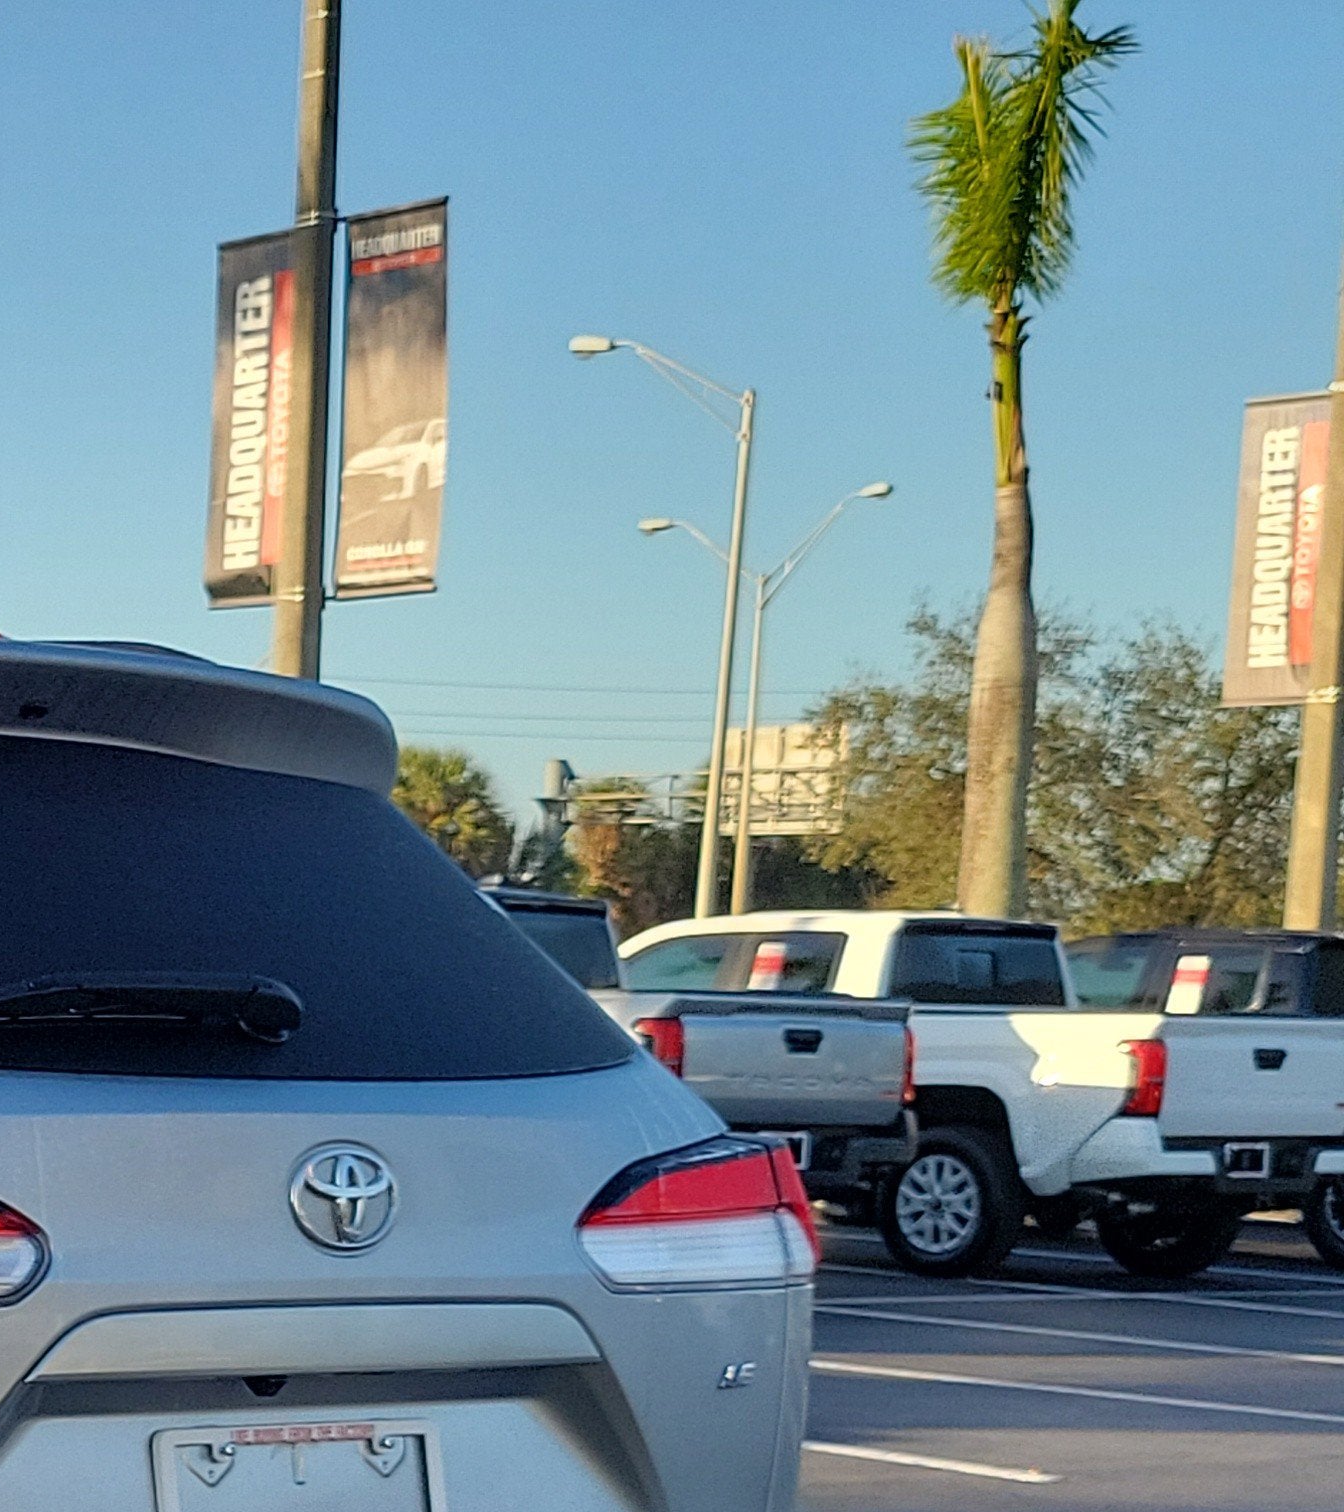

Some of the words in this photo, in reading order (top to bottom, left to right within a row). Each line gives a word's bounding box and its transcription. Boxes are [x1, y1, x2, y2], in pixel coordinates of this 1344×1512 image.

[223, 274, 272, 570] HEADQUARTER
[271, 348, 292, 459] TOYOTA
[1247, 426, 1300, 668] HEADQUARTER
[1294, 484, 1323, 576] TOYOTA
